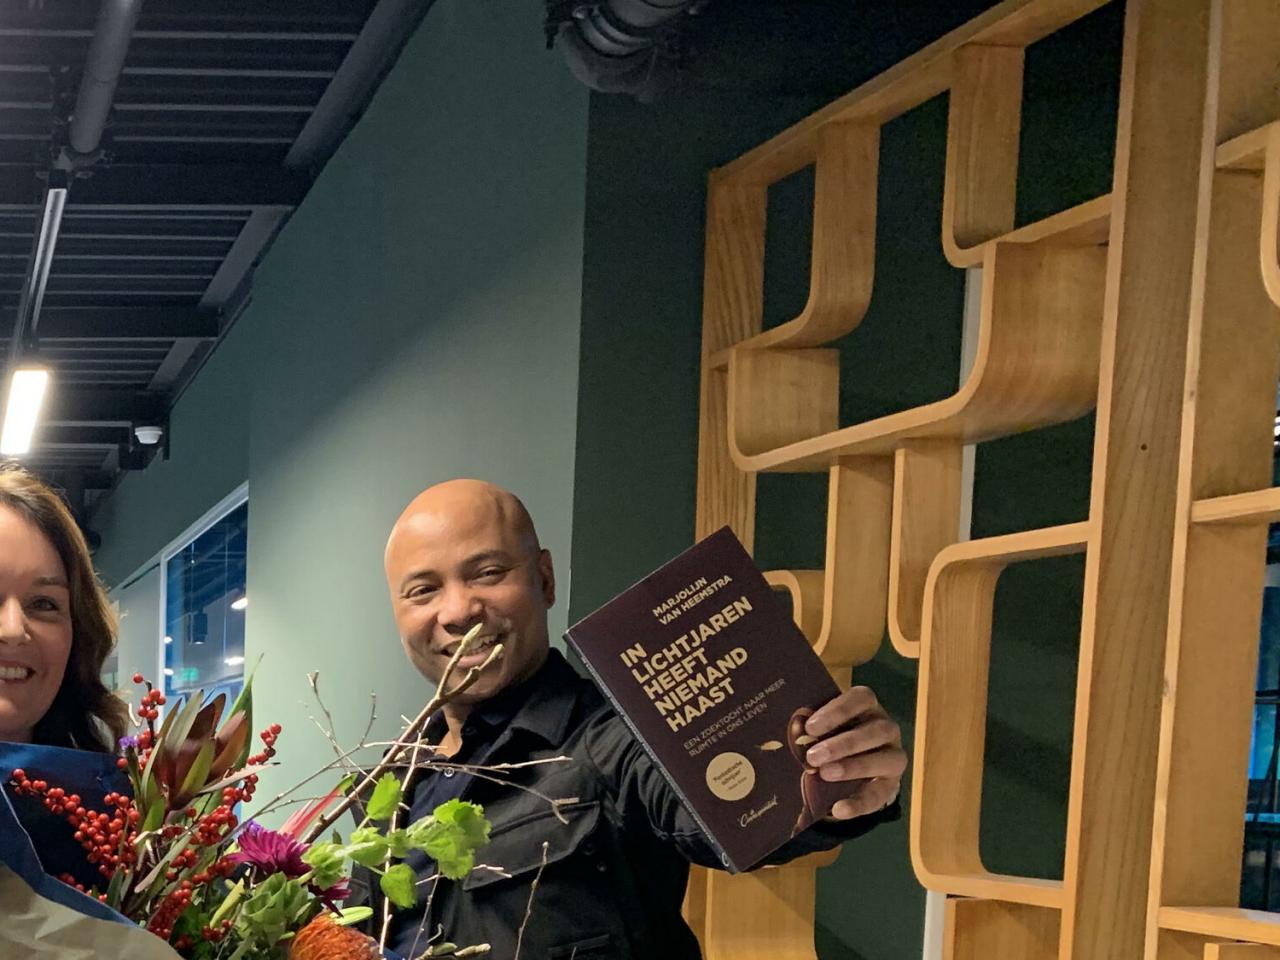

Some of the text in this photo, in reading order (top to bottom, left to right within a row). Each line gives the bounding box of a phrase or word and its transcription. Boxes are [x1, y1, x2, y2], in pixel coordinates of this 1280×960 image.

[652, 577, 708, 617] MARJOLIJN
[658, 575, 733, 625] VAN HEEMSTRA
[619, 643, 648, 667] IN
[631, 596, 753, 684] LICHTJAREN
[643, 647, 709, 700] HEEFT
[654, 647, 748, 716] NIEMAND
[666, 678, 735, 732] HAAST
[683, 678, 786, 750] EEN ZOEKTOCHT NAAR MEER
[689, 702, 768, 758] RUIMTE IN ONS LEVEN
